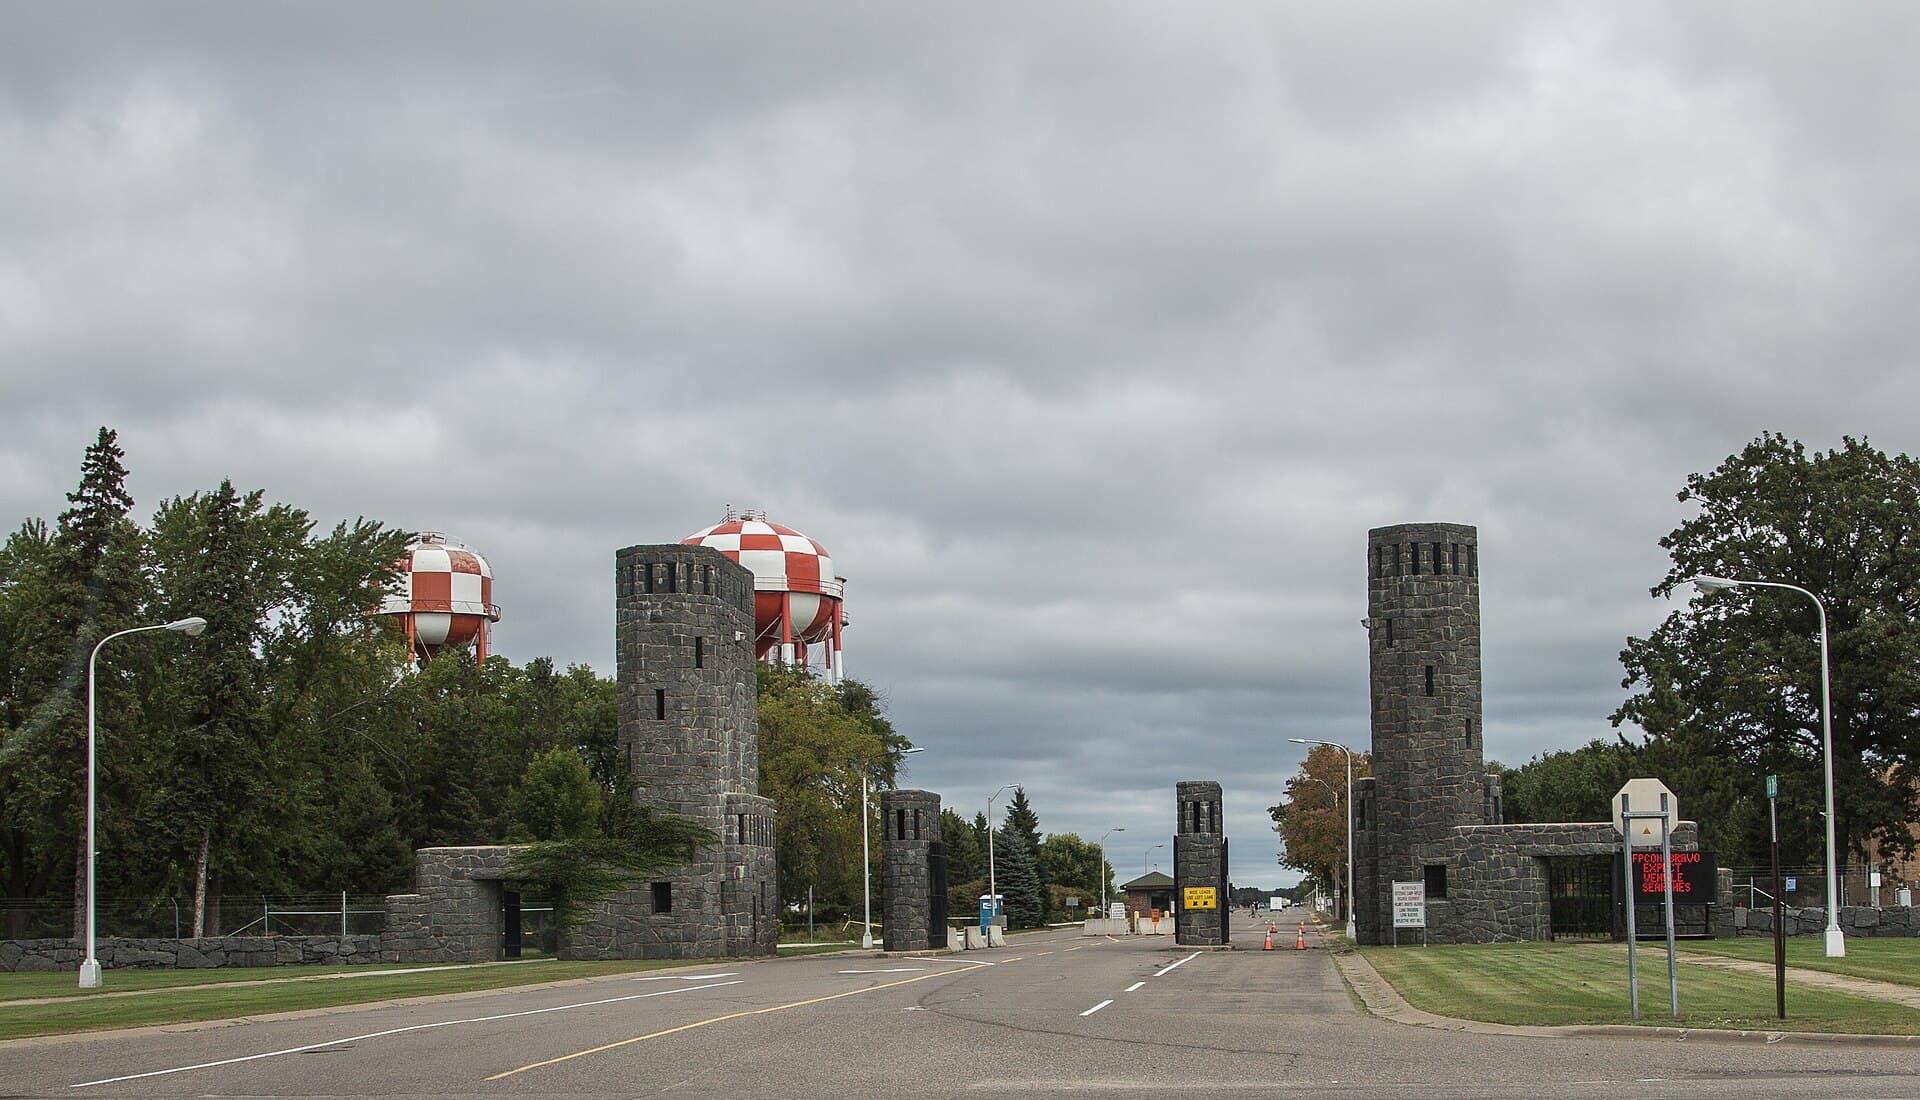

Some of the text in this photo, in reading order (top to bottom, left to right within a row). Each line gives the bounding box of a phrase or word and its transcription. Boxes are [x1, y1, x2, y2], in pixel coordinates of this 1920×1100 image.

[1632, 853, 1701, 863] FPCON BRAVO
[1642, 882, 1691, 893] SEARHES
